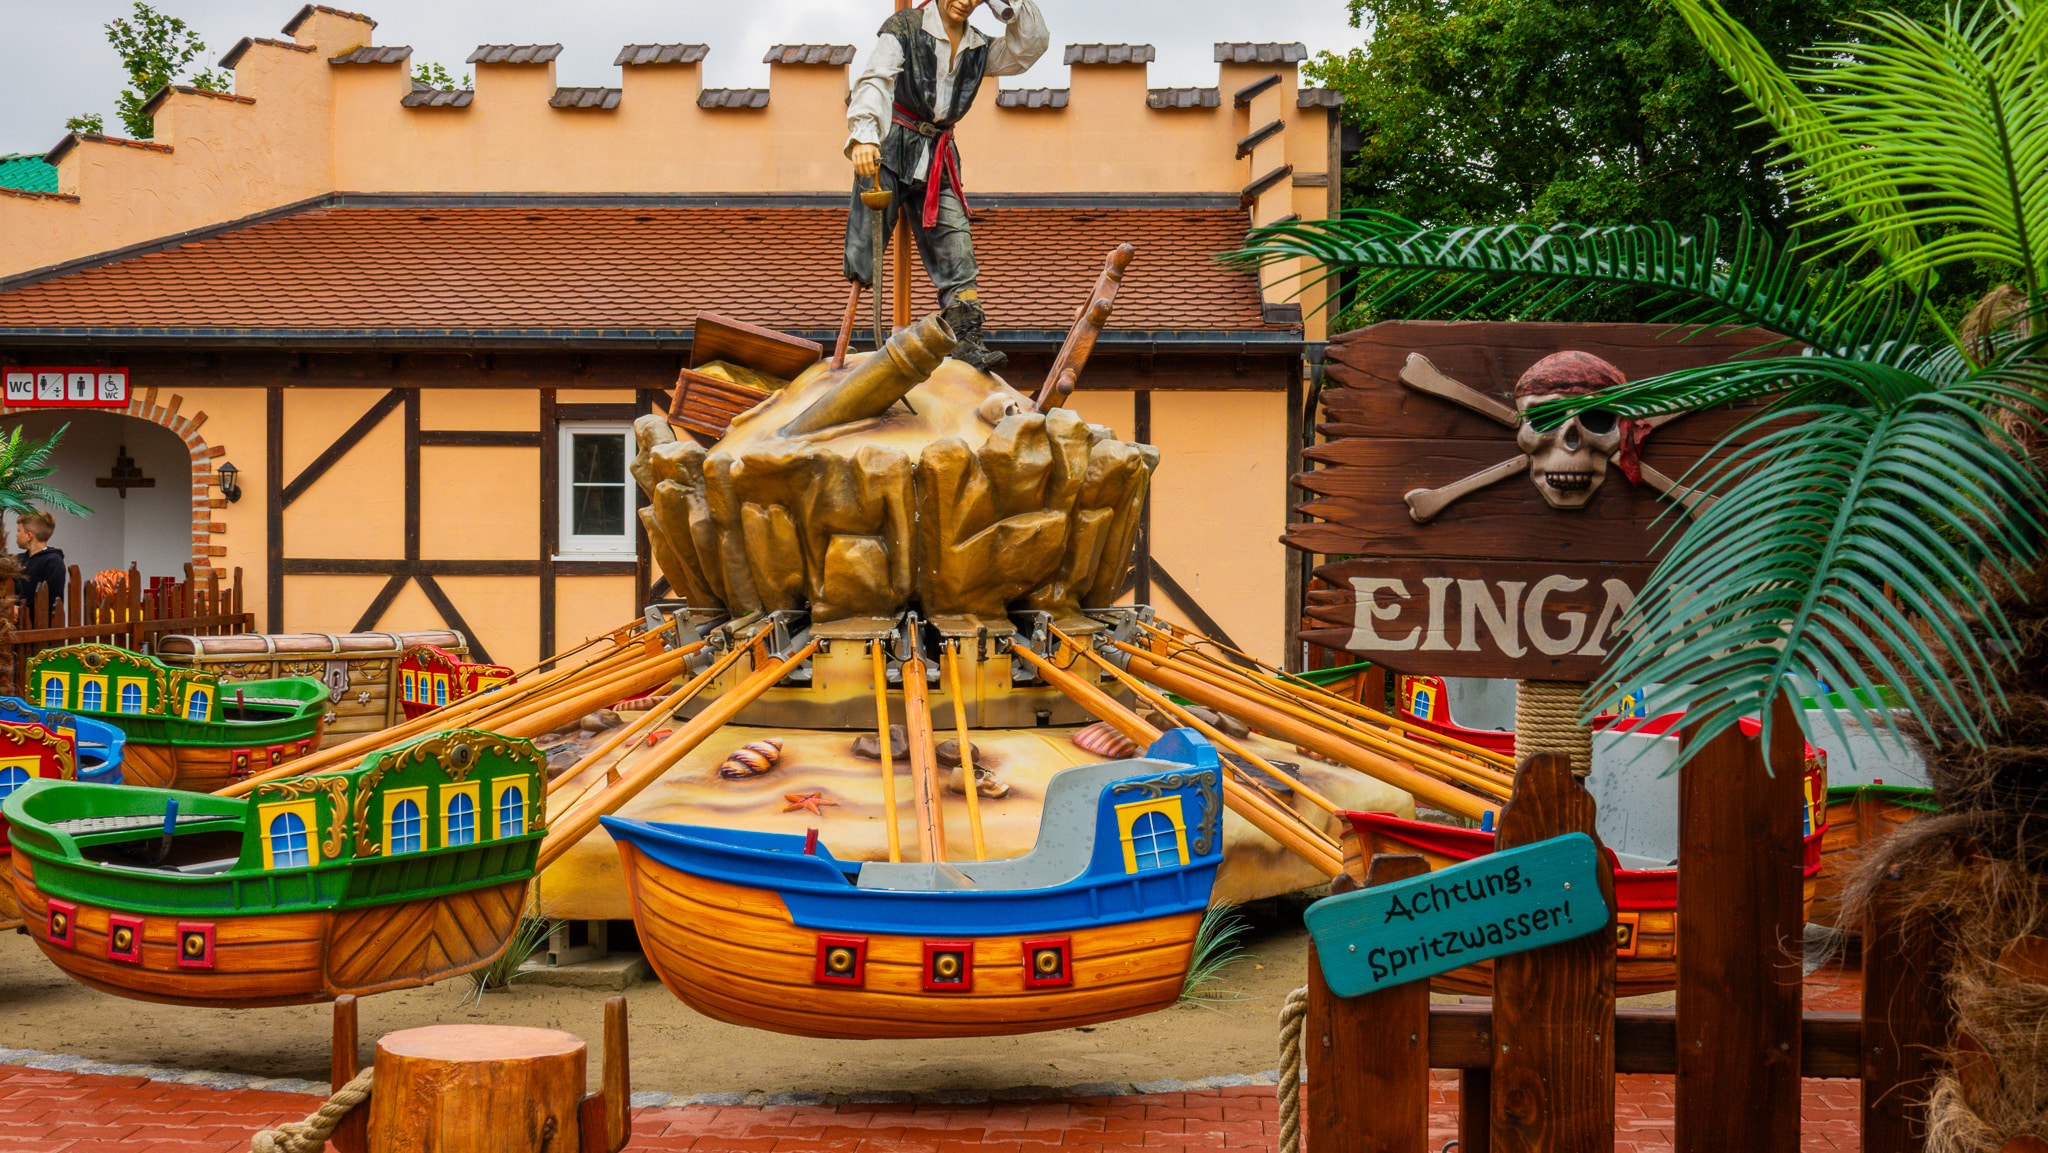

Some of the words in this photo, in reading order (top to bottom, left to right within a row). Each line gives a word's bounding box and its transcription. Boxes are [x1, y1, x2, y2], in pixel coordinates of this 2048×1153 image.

[9, 381, 32, 393] WC
[1345, 574, 1796, 661] EINGA
[460, 749, 468, 764] 9
[1384, 865, 1532, 924] Achtung,
[1368, 901, 1573, 982] Spritzwasser!
